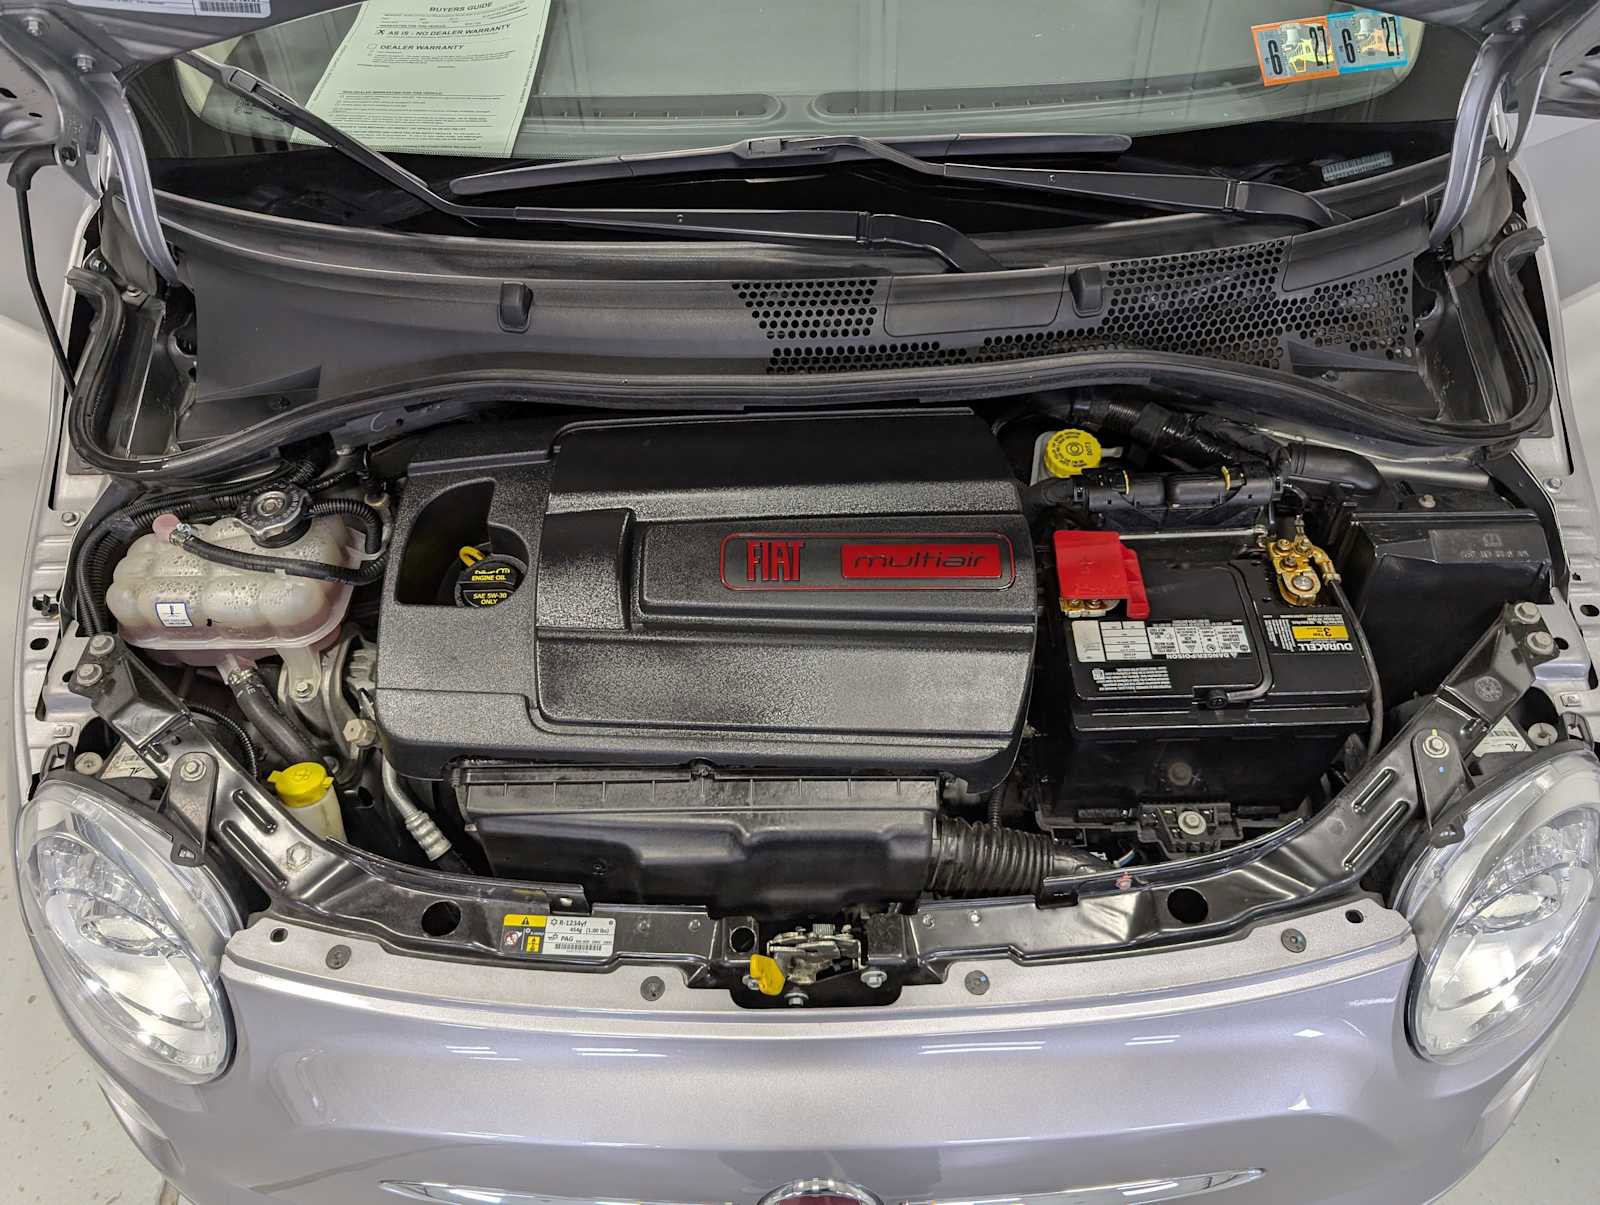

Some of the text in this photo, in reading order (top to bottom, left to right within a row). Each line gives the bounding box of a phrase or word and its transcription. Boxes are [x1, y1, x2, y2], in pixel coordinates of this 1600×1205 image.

[467, 2, 493, 11] GUIDE
[464, 24, 511, 34] WARRANTY
[1381, 16, 1400, 57] 27
[1309, 26, 1329, 67] 27
[1342, 28, 1356, 64] 6
[1267, 39, 1283, 75] 6
[746, 539, 803, 581] FIAT
[853, 551, 988, 568] multiair
[1323, 627, 1332, 637] 3
[1297, 642, 1353, 651] DURACELL
[560, 919, 588, 927] R-1234yf
